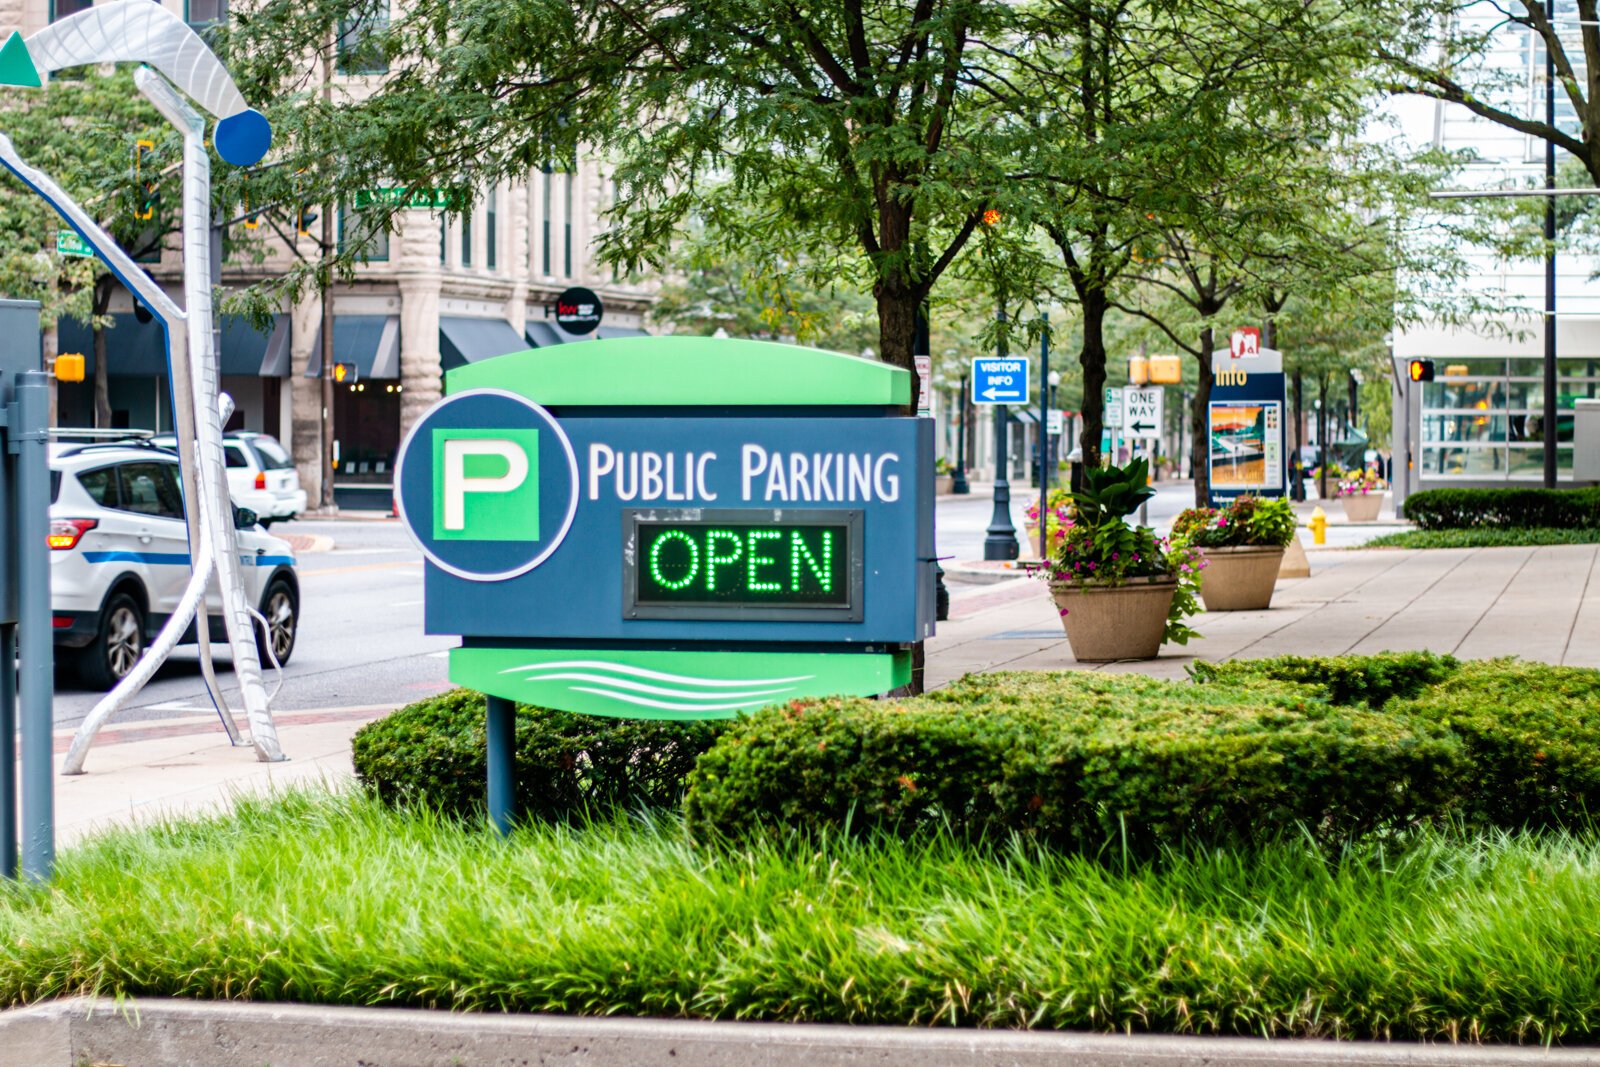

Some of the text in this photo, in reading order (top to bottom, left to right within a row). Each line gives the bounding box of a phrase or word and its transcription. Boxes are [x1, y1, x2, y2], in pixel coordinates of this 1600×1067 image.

[980, 362, 1021, 372] VISITOR
[1215, 363, 1247, 387] Info
[988, 376, 1013, 386] INFO
[1130, 392, 1155, 403] ONE
[1129, 406, 1156, 417] WAY
[589, 443, 900, 502] PUBLIC PARKING
[444, 439, 529, 530] P
[650, 529, 832, 591] OPEN
